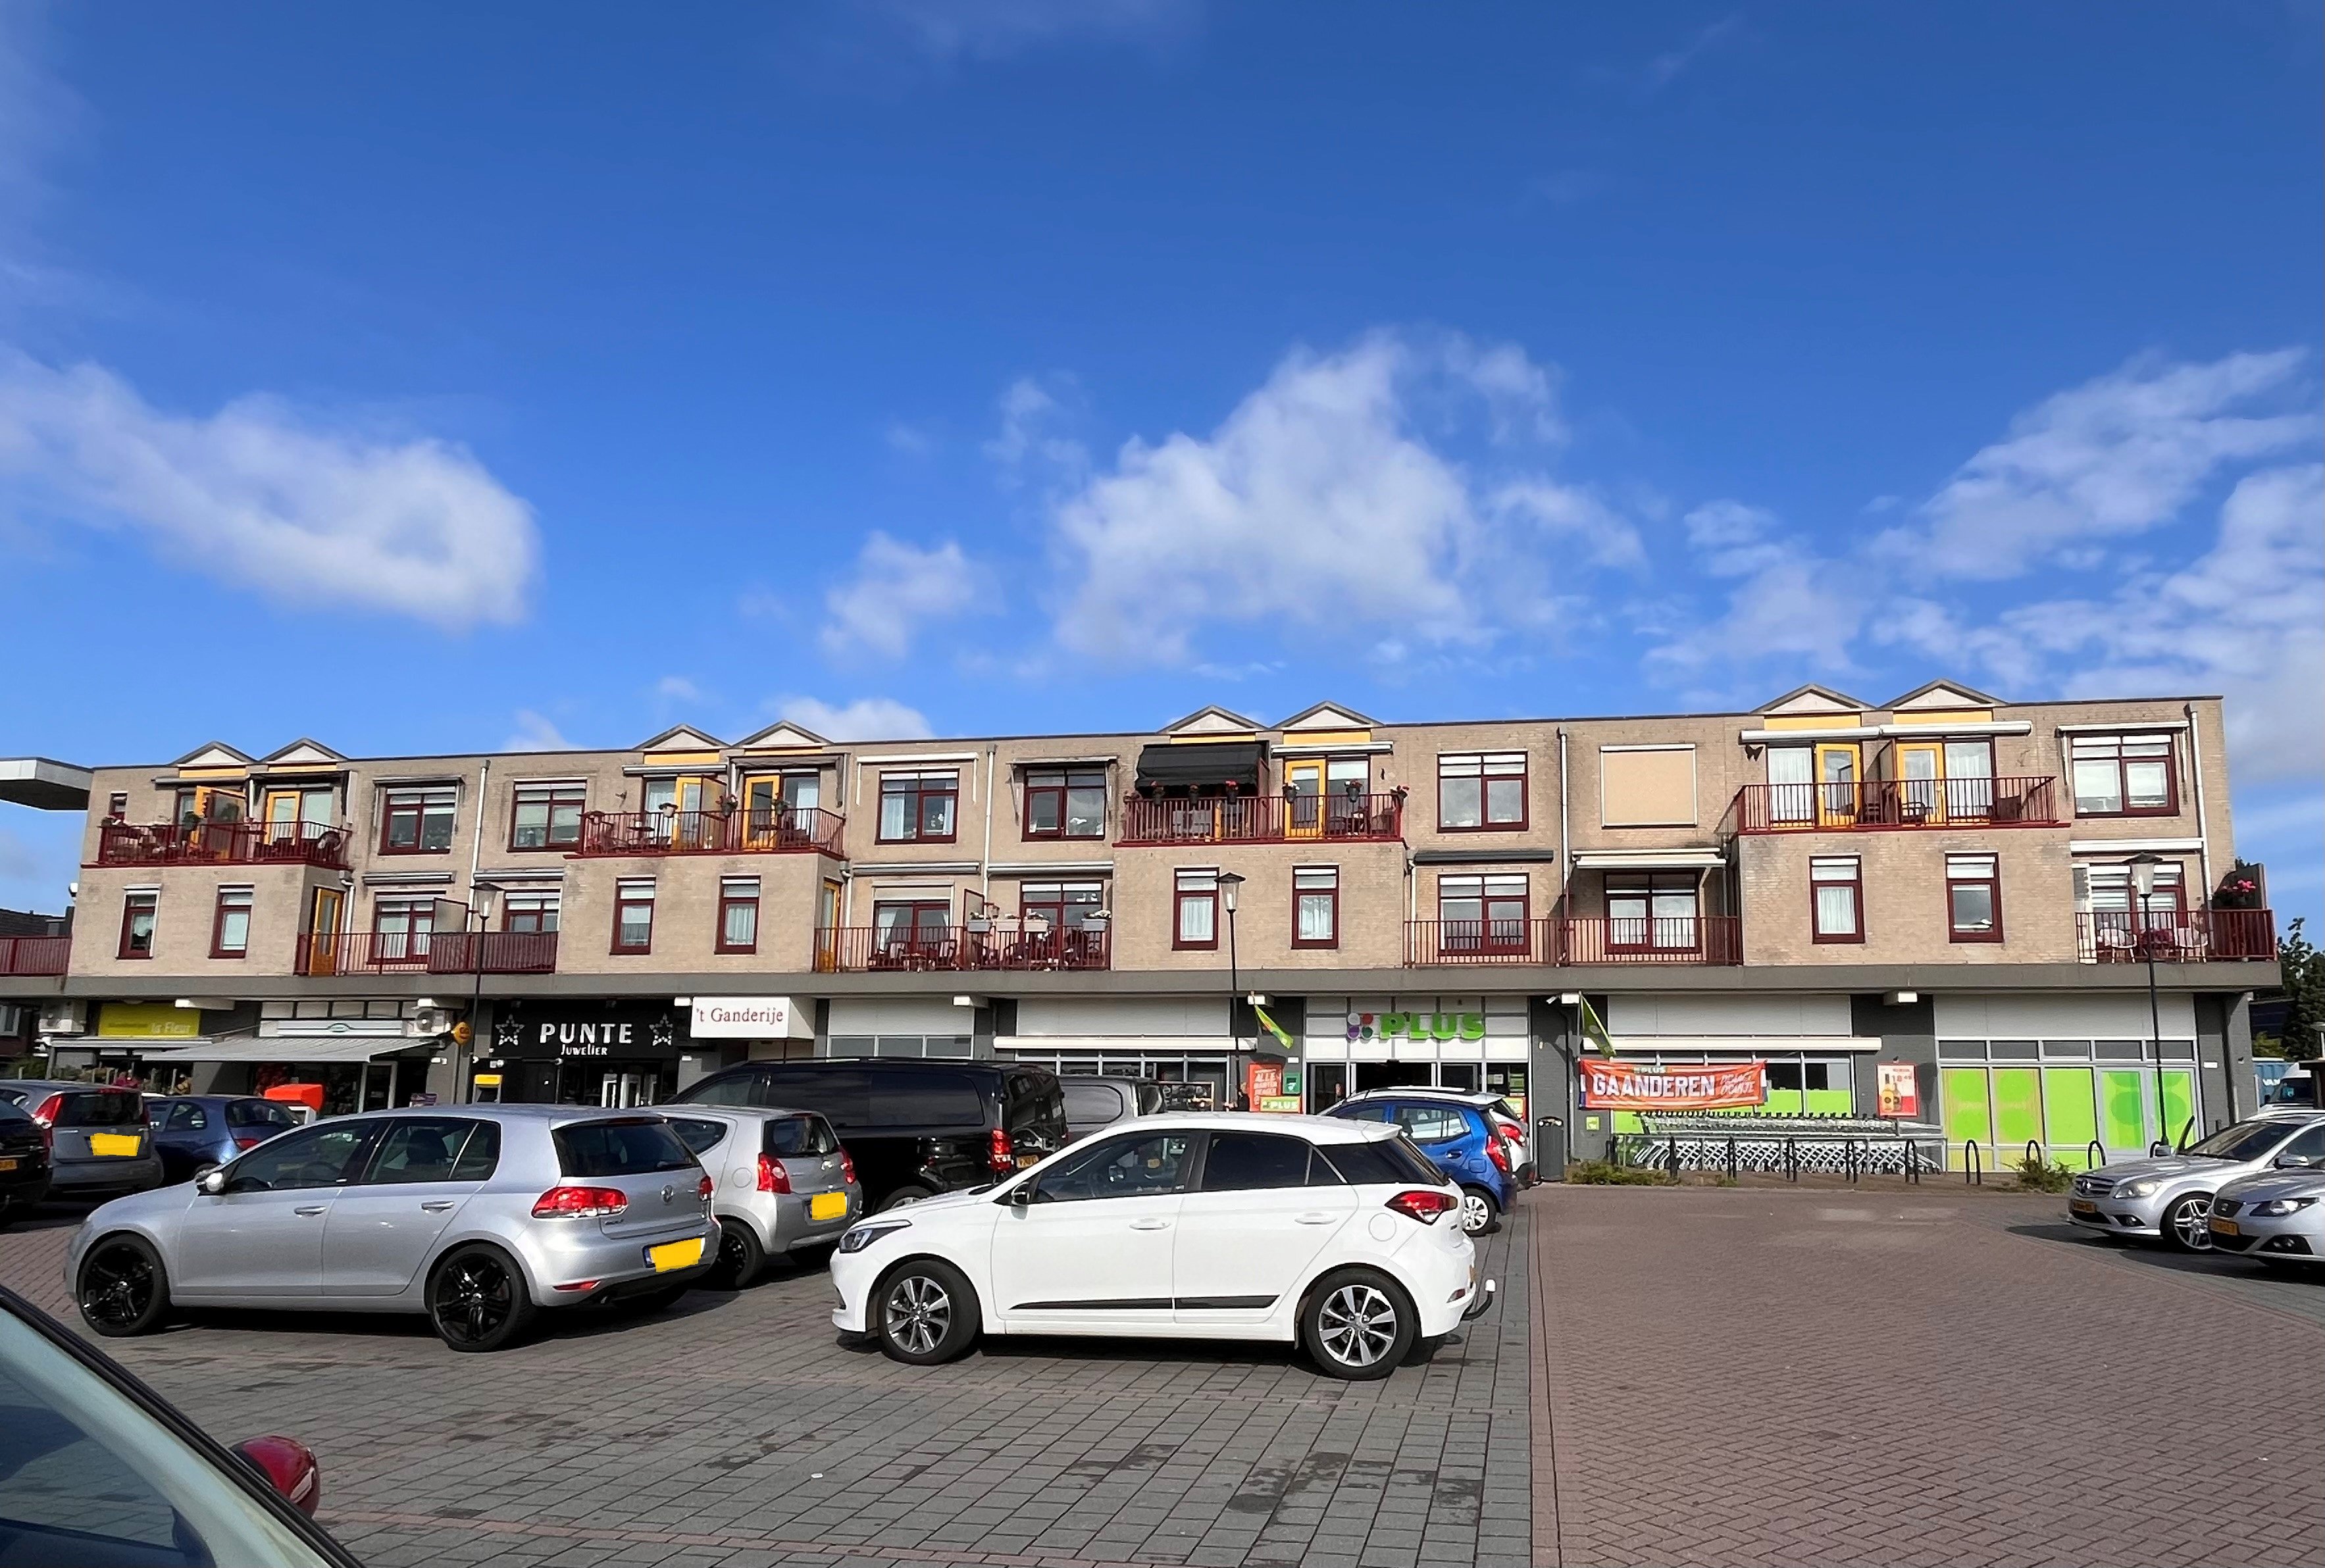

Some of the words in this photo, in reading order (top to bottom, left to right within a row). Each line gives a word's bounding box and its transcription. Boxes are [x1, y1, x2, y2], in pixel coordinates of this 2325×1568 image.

[696, 1007, 704, 1023] 't
[711, 1007, 784, 1025] Ganderije
[1380, 1012, 1486, 1040] PLUS
[540, 1023, 633, 1044] PUNTE
[1593, 1072, 1716, 1098] GAANDEREN
[1269, 1101, 1298, 1109] PLUS
